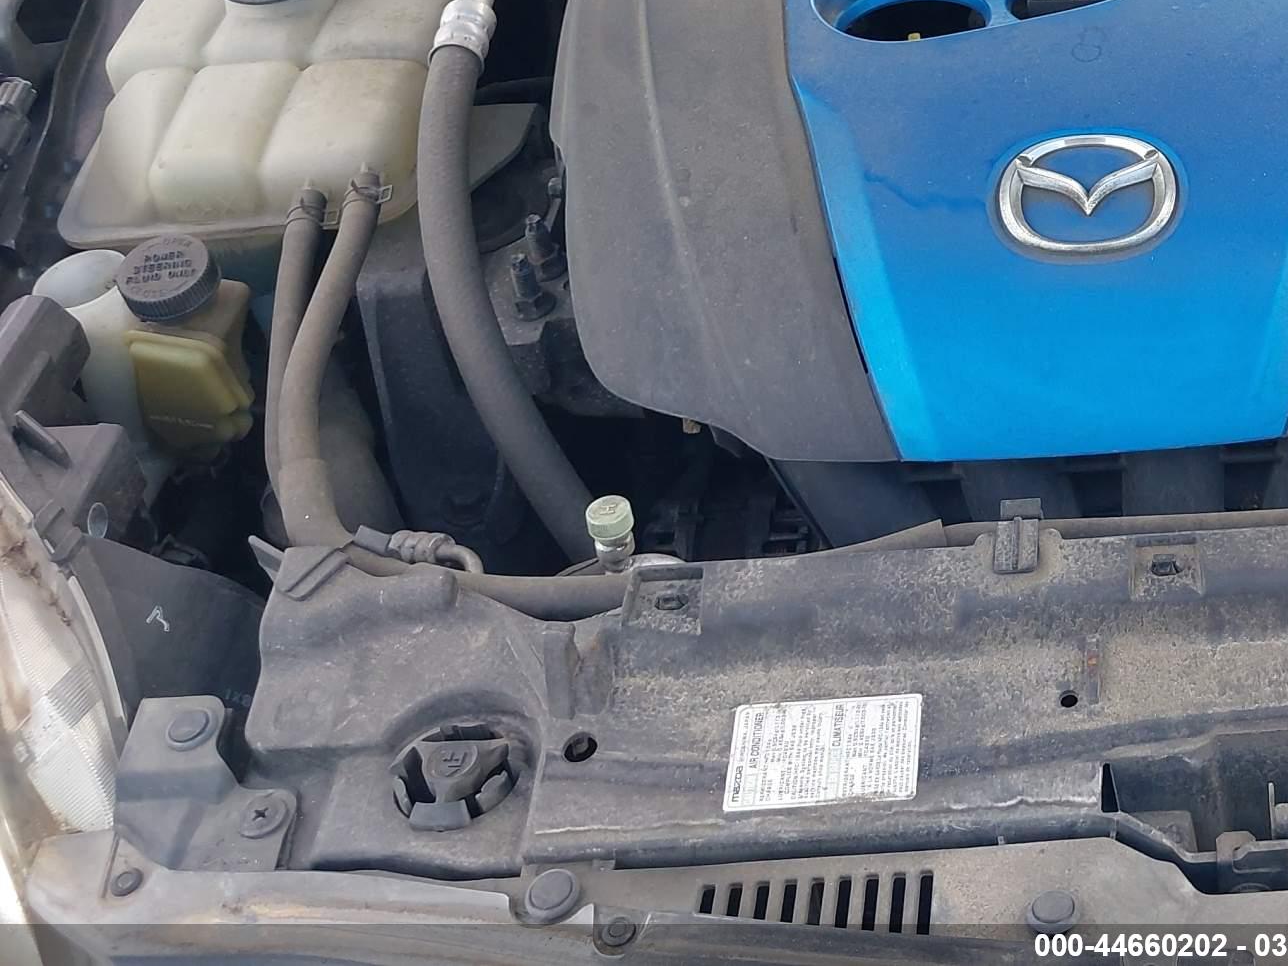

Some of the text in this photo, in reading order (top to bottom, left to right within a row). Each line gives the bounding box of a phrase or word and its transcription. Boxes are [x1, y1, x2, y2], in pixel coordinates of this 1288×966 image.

[747, 711, 764, 769] AIR CONDITIONER
[831, 703, 845, 747] CLIMATISEUR
[730, 764, 744, 802] mazda
